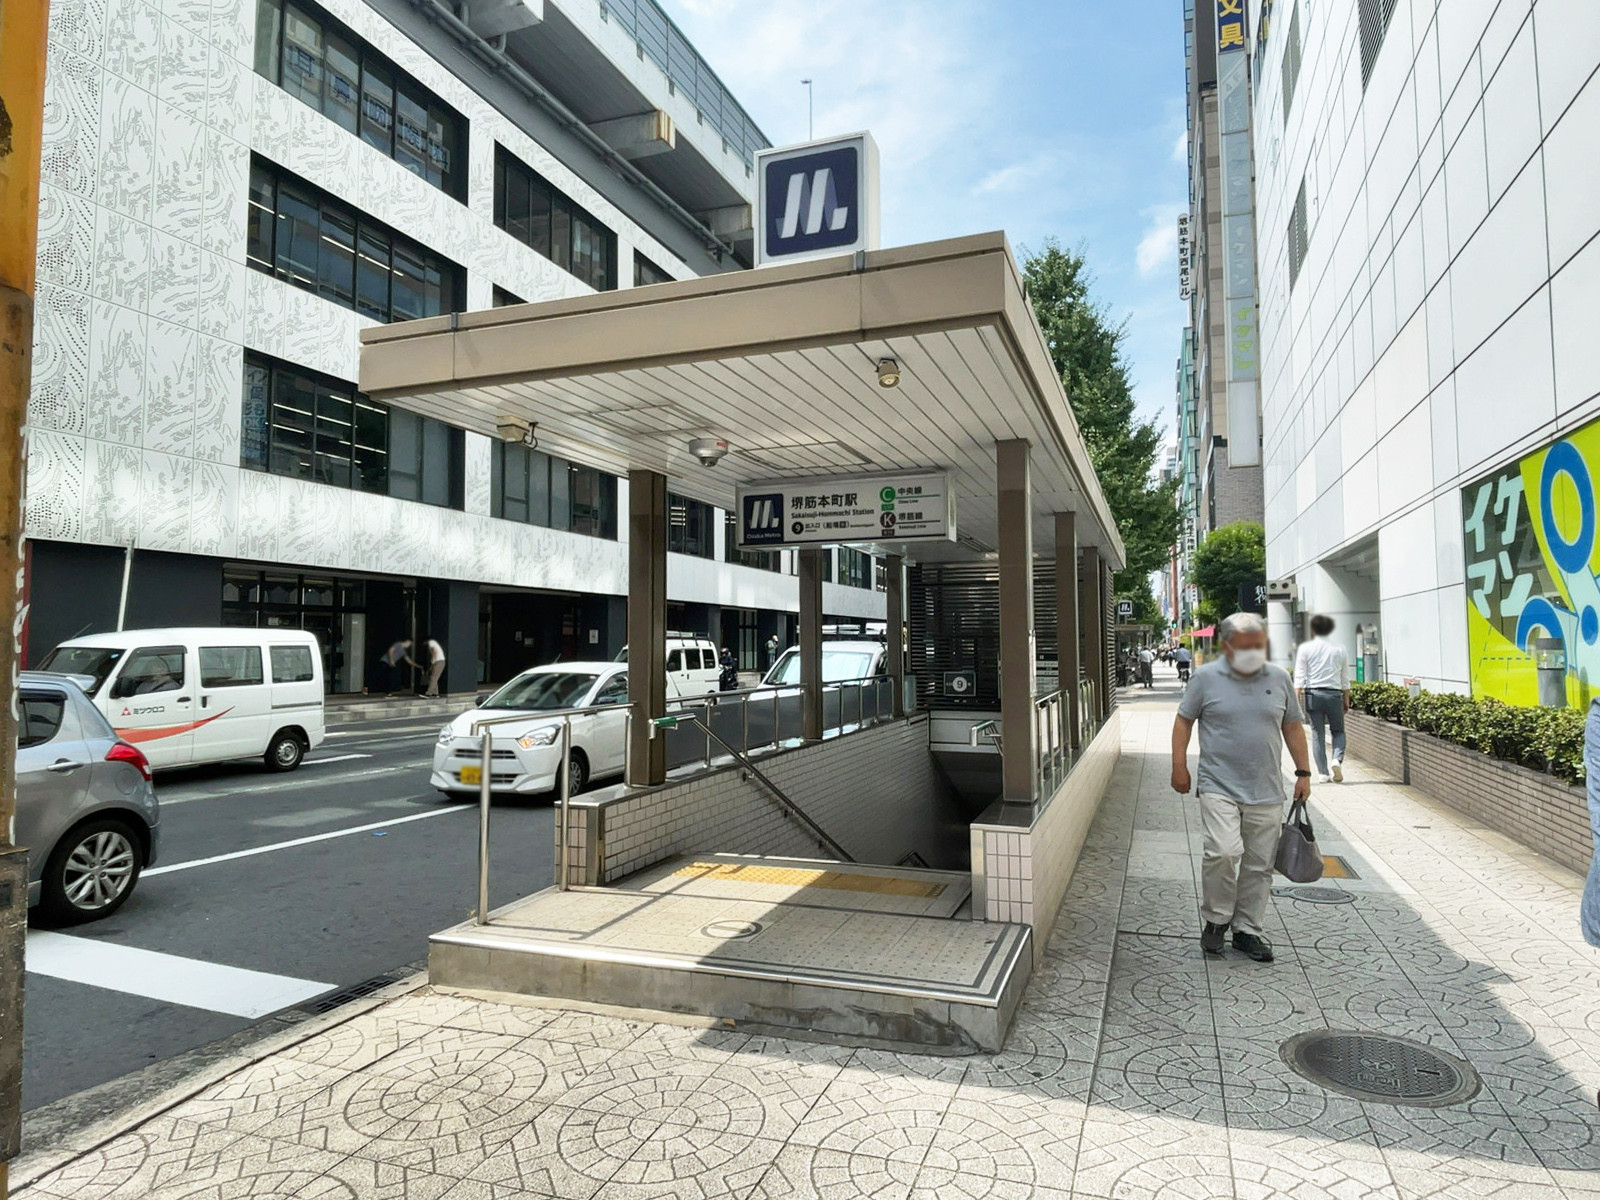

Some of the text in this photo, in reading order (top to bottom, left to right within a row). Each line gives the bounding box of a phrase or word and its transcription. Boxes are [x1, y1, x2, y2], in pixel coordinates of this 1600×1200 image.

[898, 486, 922, 495] 中央線
[791, 493, 858, 510] 堺筋本町駅
[791, 508, 874, 519] Sakaisuji-Hommachi Station
[957, 680, 963, 689] 9
[133, 706, 165, 715] ミツウロコ
